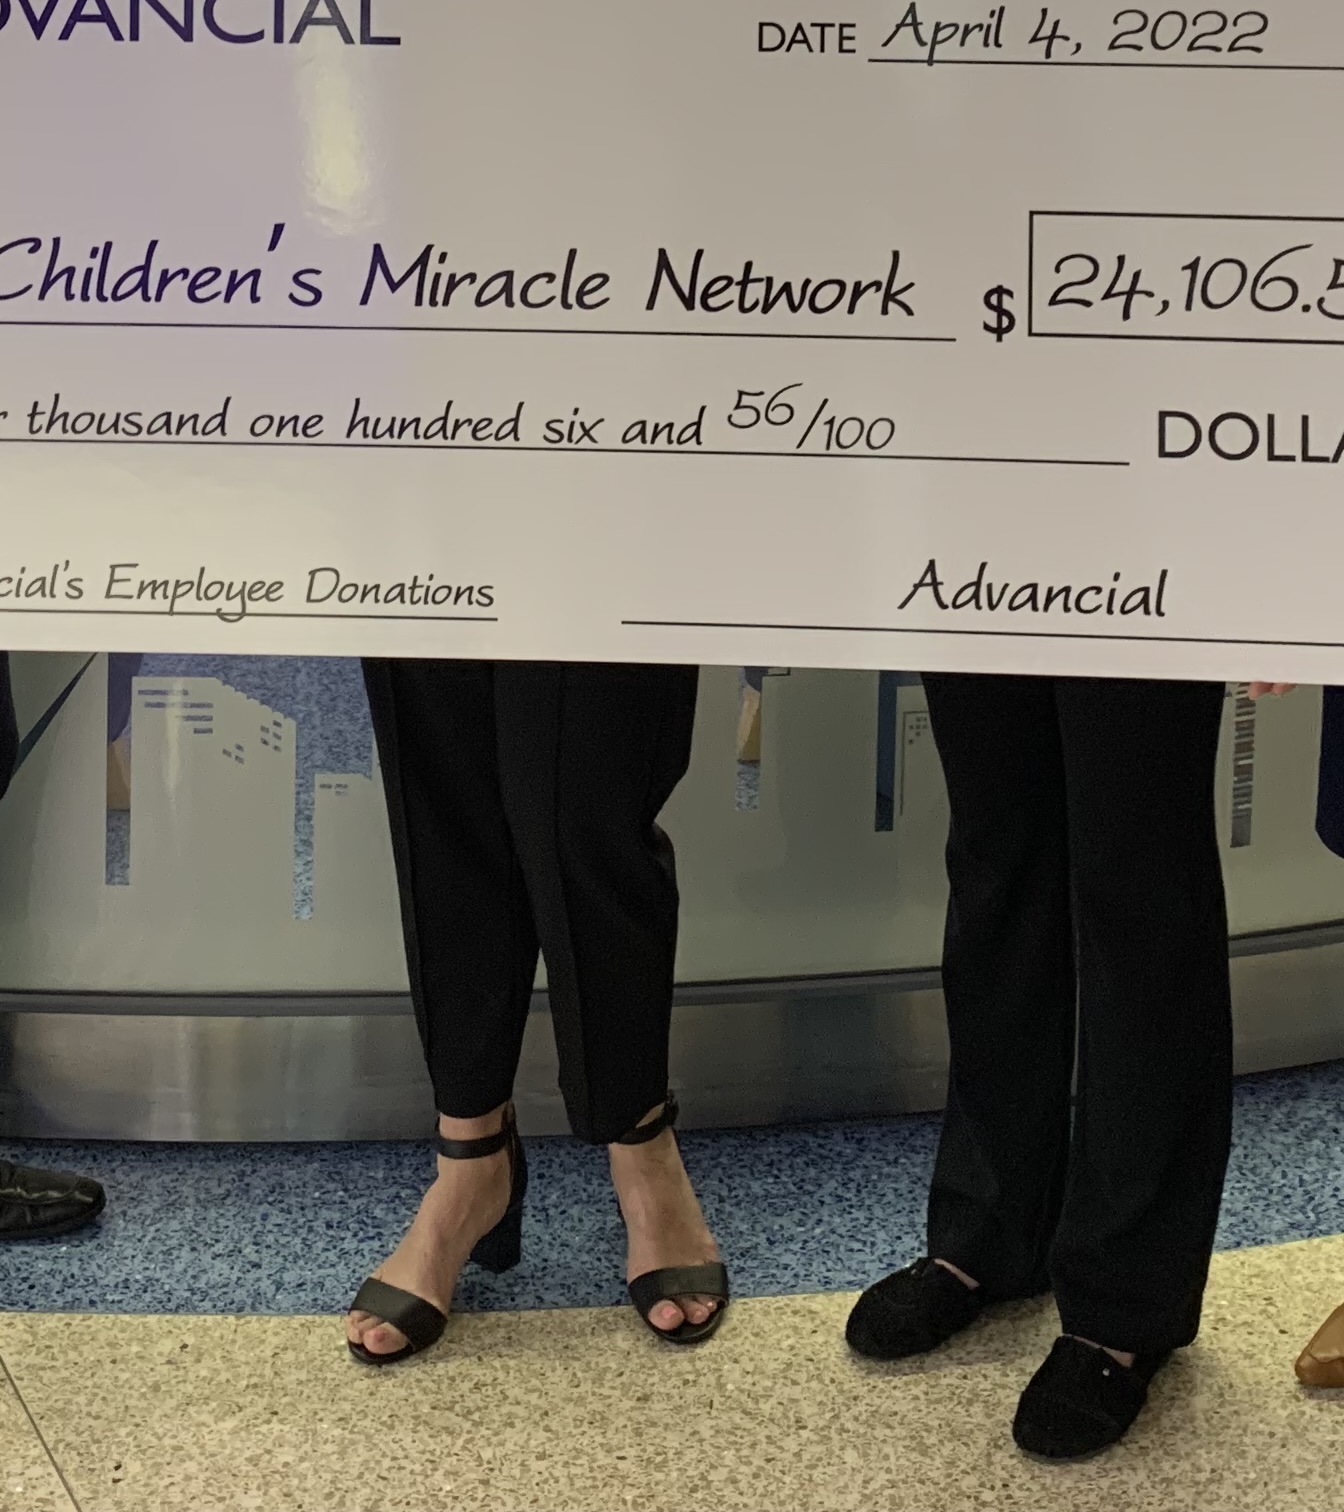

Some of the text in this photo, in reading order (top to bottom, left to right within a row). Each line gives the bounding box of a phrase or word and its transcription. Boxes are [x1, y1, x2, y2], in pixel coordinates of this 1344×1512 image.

[758, 1, 1269, 66] DATE April 4, 2022
[359, 243, 611, 310] Miracle
[645, 248, 916, 316] Network
[982, 285, 1016, 342] $
[27, 393, 232, 437] thousand
[249, 414, 324, 439] one
[346, 398, 524, 442] hundred
[543, 407, 605, 445] six
[620, 405, 707, 446] and
[727, 383, 896, 452] 56/100
[104, 564, 284, 623] Employee
[306, 567, 495, 607] Donations
[897, 559, 1169, 617] Advancial
